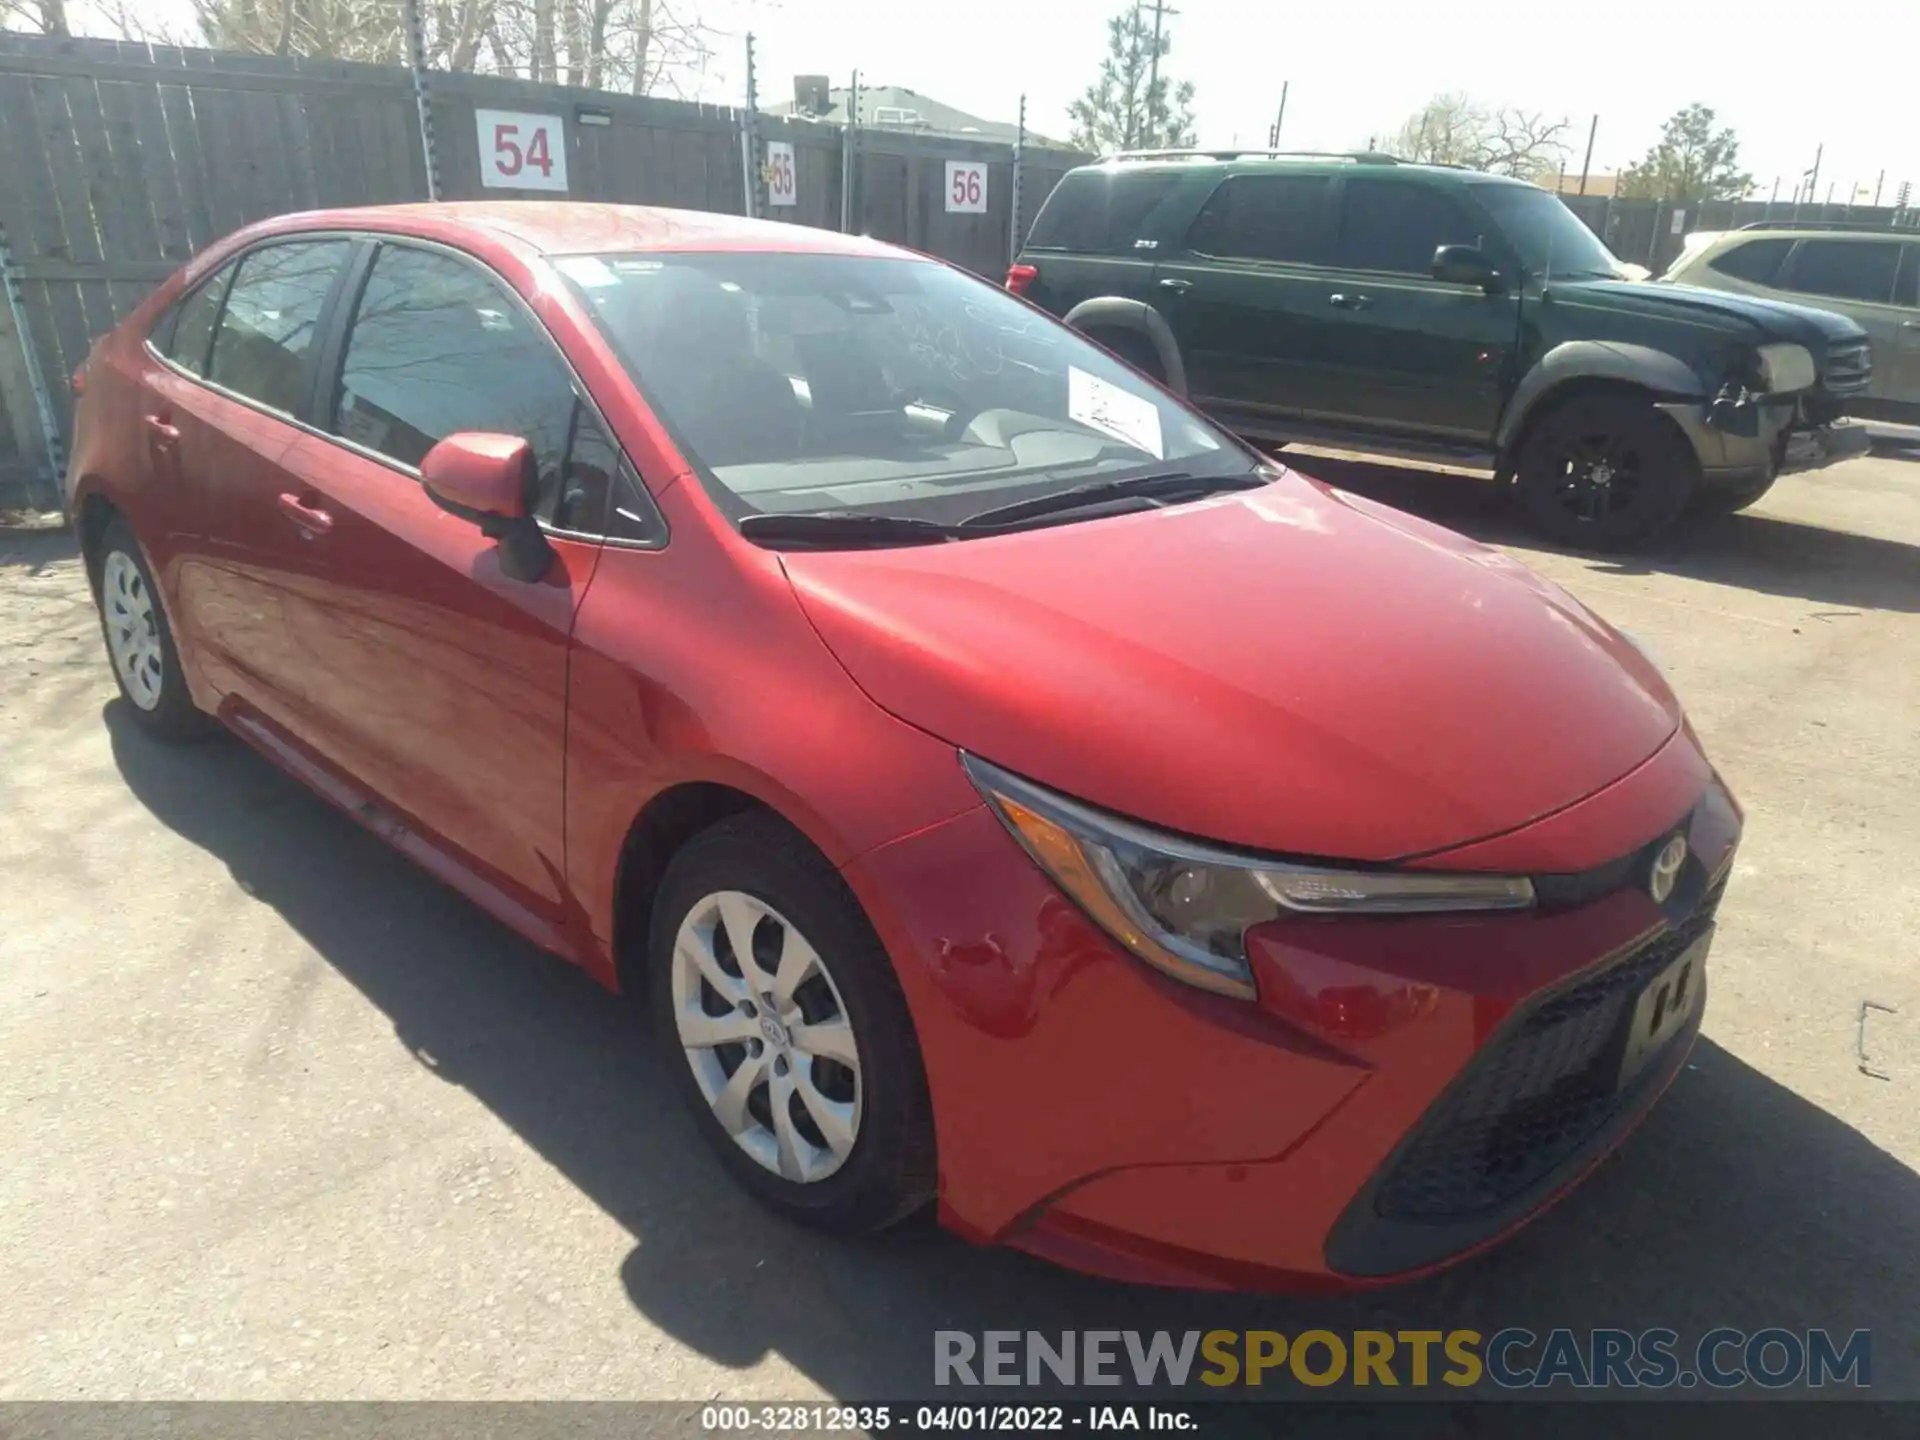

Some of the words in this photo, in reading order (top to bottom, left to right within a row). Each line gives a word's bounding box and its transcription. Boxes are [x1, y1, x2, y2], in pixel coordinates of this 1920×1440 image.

[494, 124, 553, 178] 54
[773, 152, 792, 195] 55
[953, 169, 981, 205] 56
